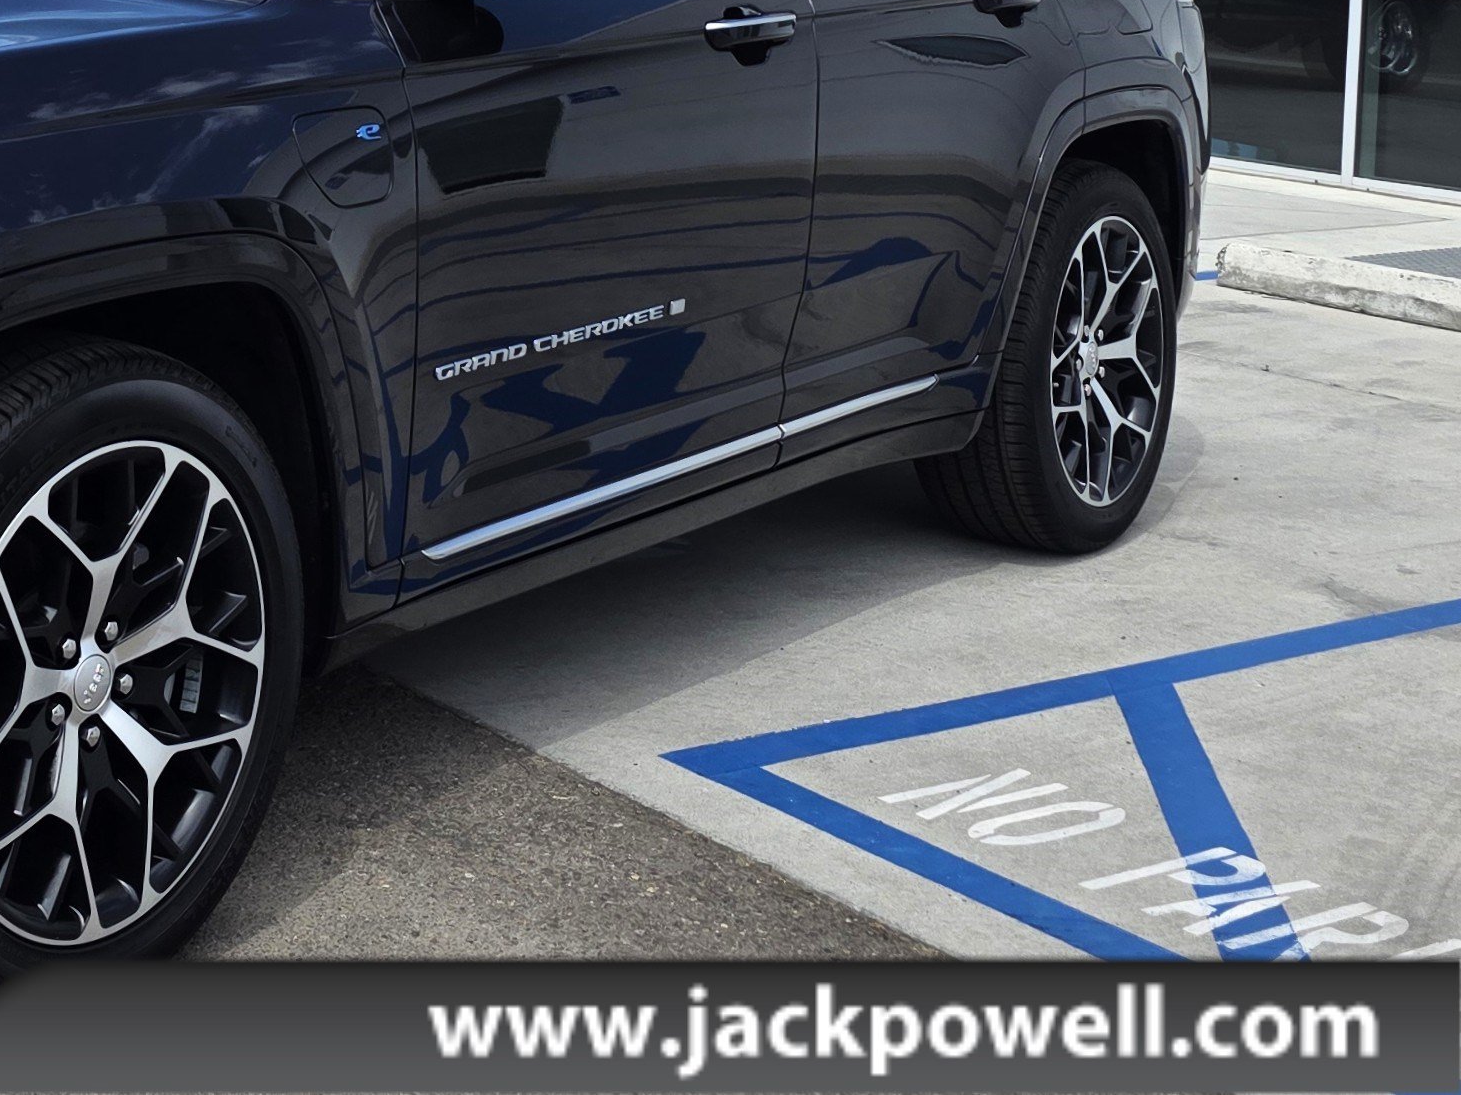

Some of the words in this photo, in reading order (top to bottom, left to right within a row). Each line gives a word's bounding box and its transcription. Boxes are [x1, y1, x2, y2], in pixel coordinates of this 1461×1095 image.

[434, 343, 528, 382] GRAND
[533, 304, 665, 353] CHEROKEE
[878, 768, 1126, 845] NO
